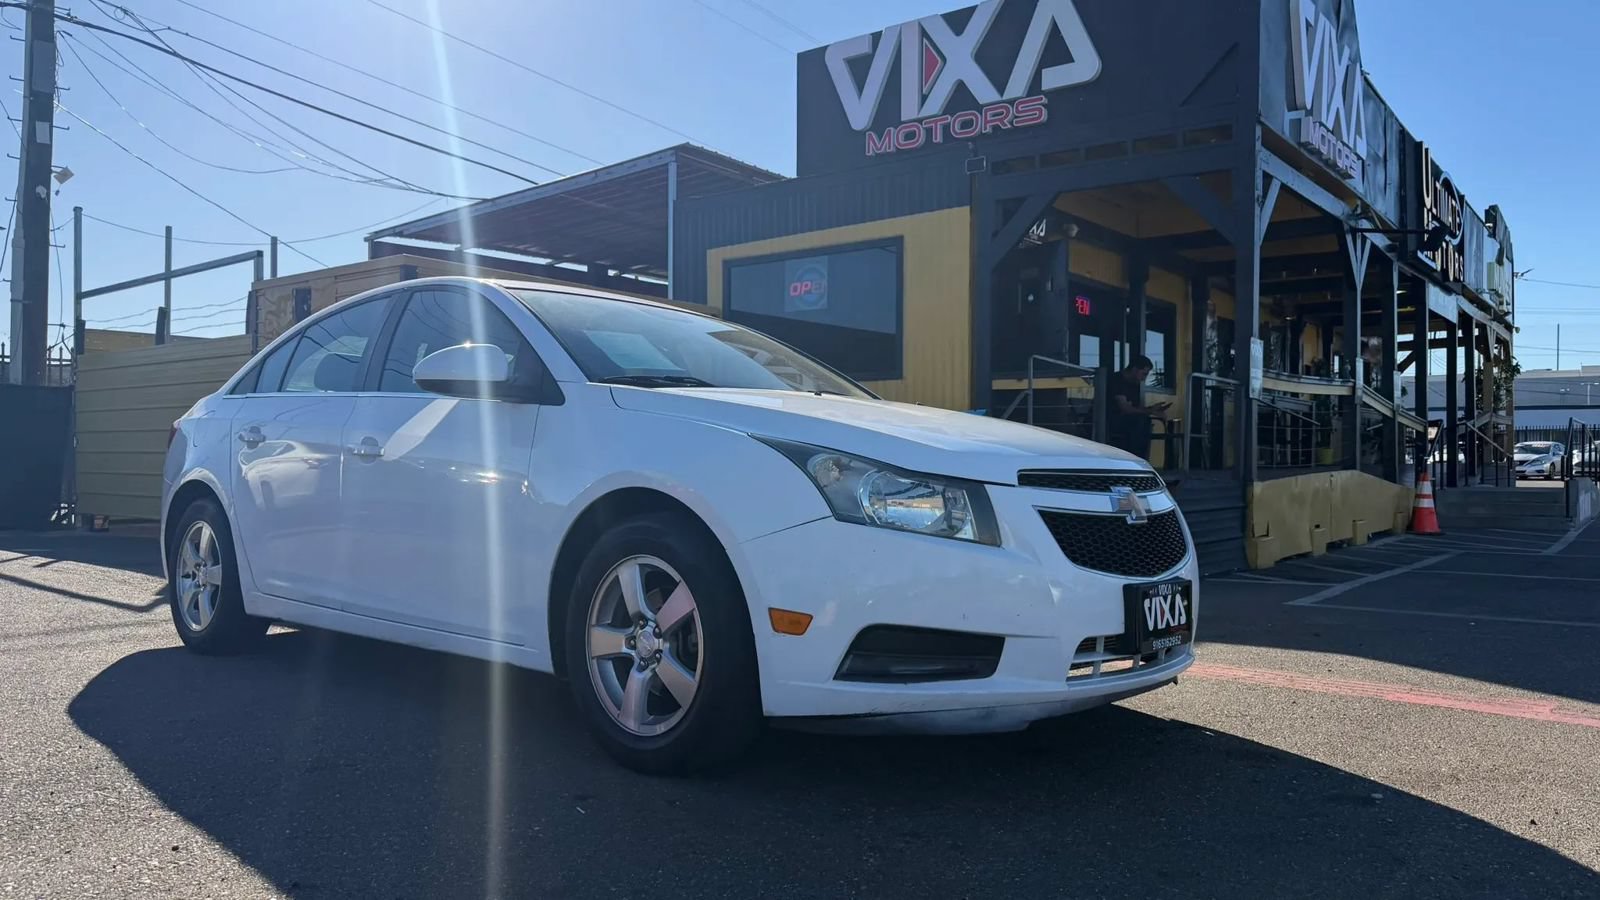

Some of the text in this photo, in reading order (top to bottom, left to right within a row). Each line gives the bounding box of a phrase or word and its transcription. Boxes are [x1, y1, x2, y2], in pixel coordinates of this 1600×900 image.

[825, 0, 1102, 131] VIXA
[1299, 0, 1366, 160] VIXA
[865, 95, 1048, 156] MOTORS
[1308, 116, 1358, 176] MOTORS
[1422, 140, 1460, 236] ULTIMATE
[1144, 593, 1187, 631] VIXA
